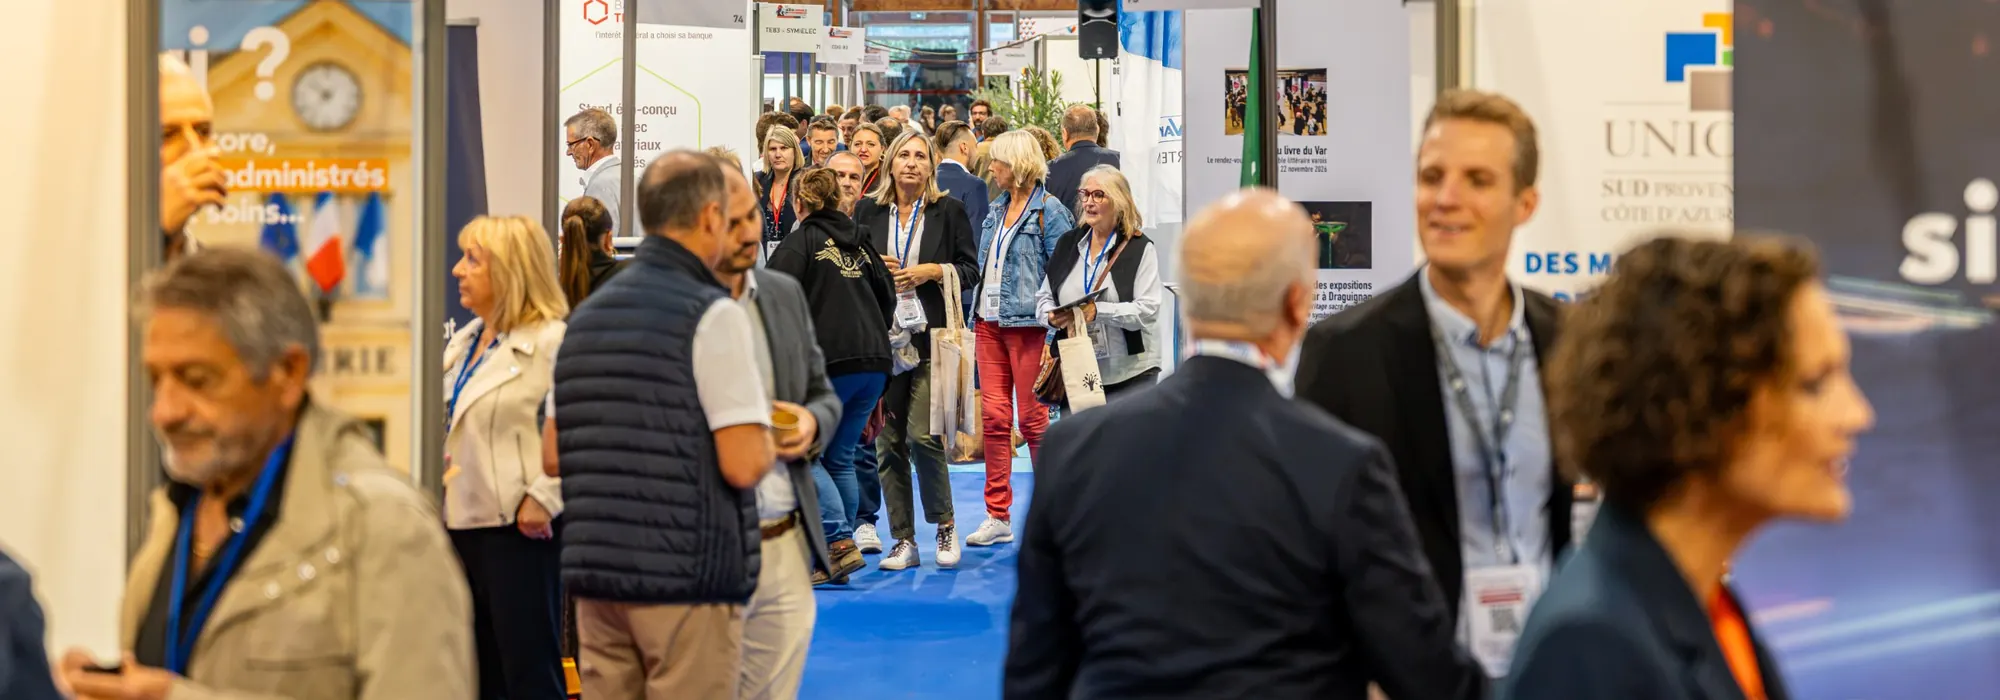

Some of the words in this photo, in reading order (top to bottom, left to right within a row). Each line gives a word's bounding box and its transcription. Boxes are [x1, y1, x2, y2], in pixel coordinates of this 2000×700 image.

[733, 14, 744, 23] 74
[688, 32, 713, 40] banque
[241, 26, 290, 101] ?
[1284, 145, 1301, 155] livre
[1303, 145, 1312, 155] du
[1314, 145, 1327, 155] Var
[1601, 179, 1649, 197] SUD
[1525, 252, 1578, 274] DES
[1329, 280, 1373, 291] expositions
[1321, 291, 1327, 301] à
[1328, 291, 1373, 304] Draguignan
